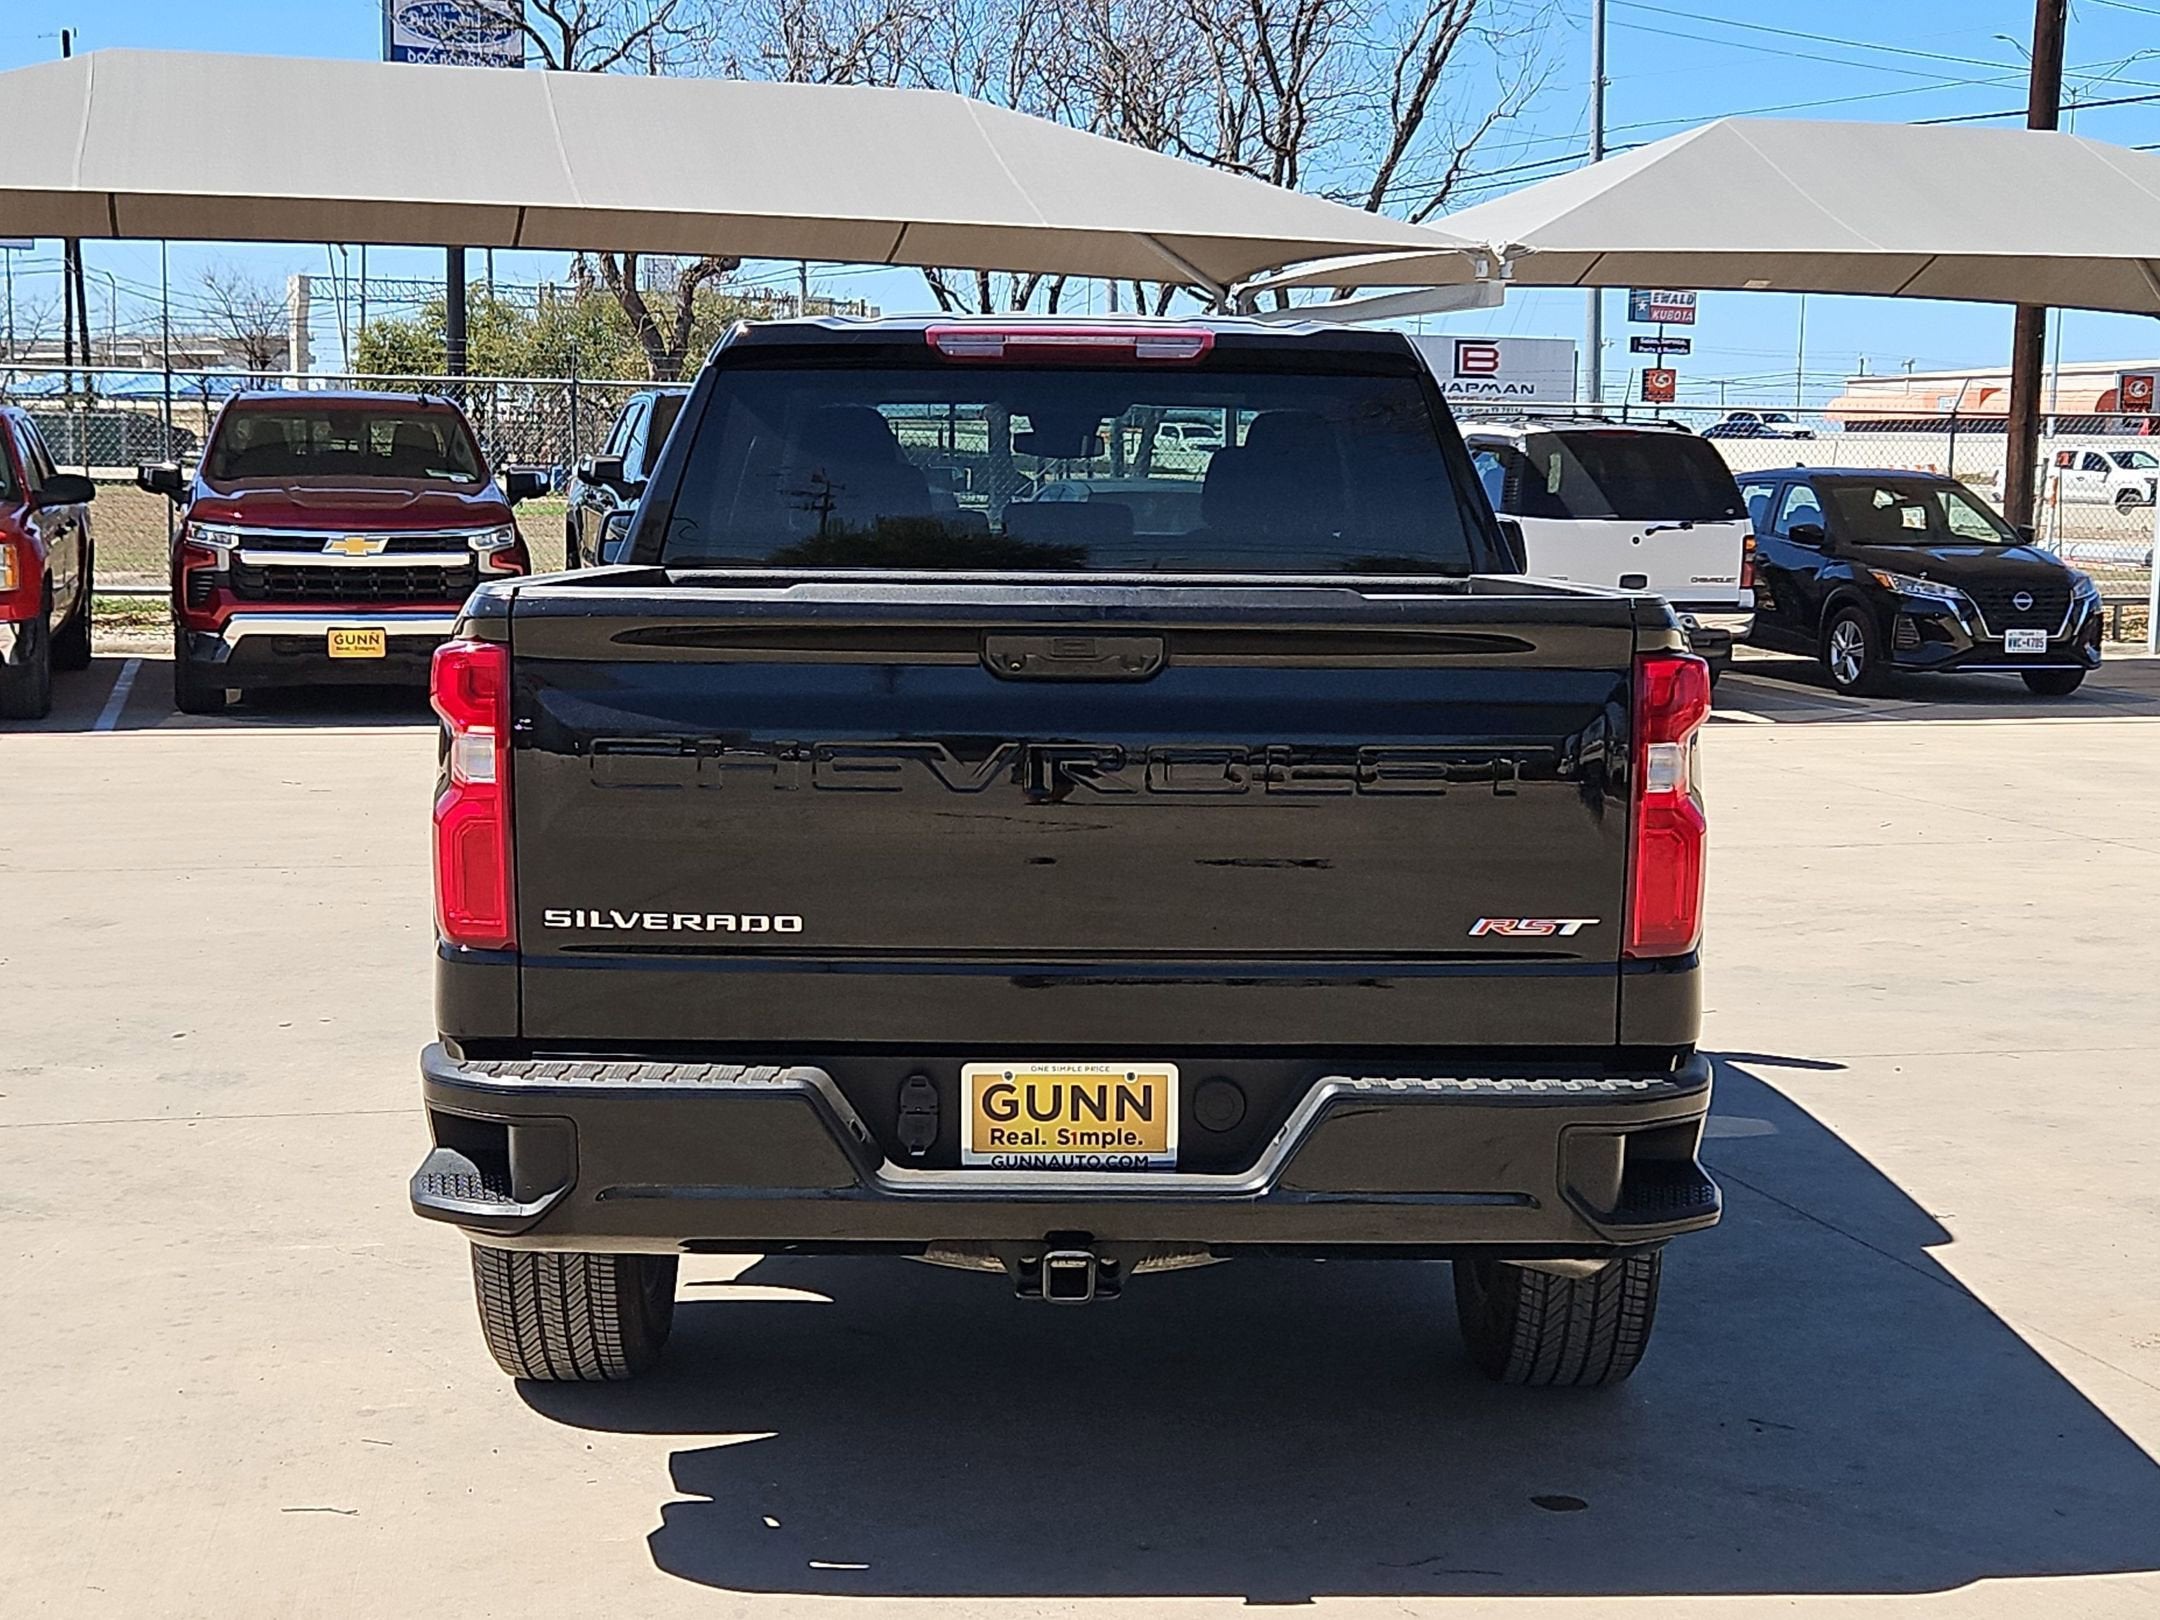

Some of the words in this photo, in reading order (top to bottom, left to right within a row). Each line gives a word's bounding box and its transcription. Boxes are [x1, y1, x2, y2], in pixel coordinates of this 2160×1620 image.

[1653, 292, 1695, 306] EWALD
[1651, 309, 1694, 322] KUBOTA
[333, 634, 380, 645] GUNN
[587, 738, 1554, 796] CHEVROLET
[544, 909, 803, 933] SILVERADO
[1467, 918, 1601, 936] RST
[981, 1083, 1153, 1122] GUNN
[990, 1127, 1047, 1146] Real.
